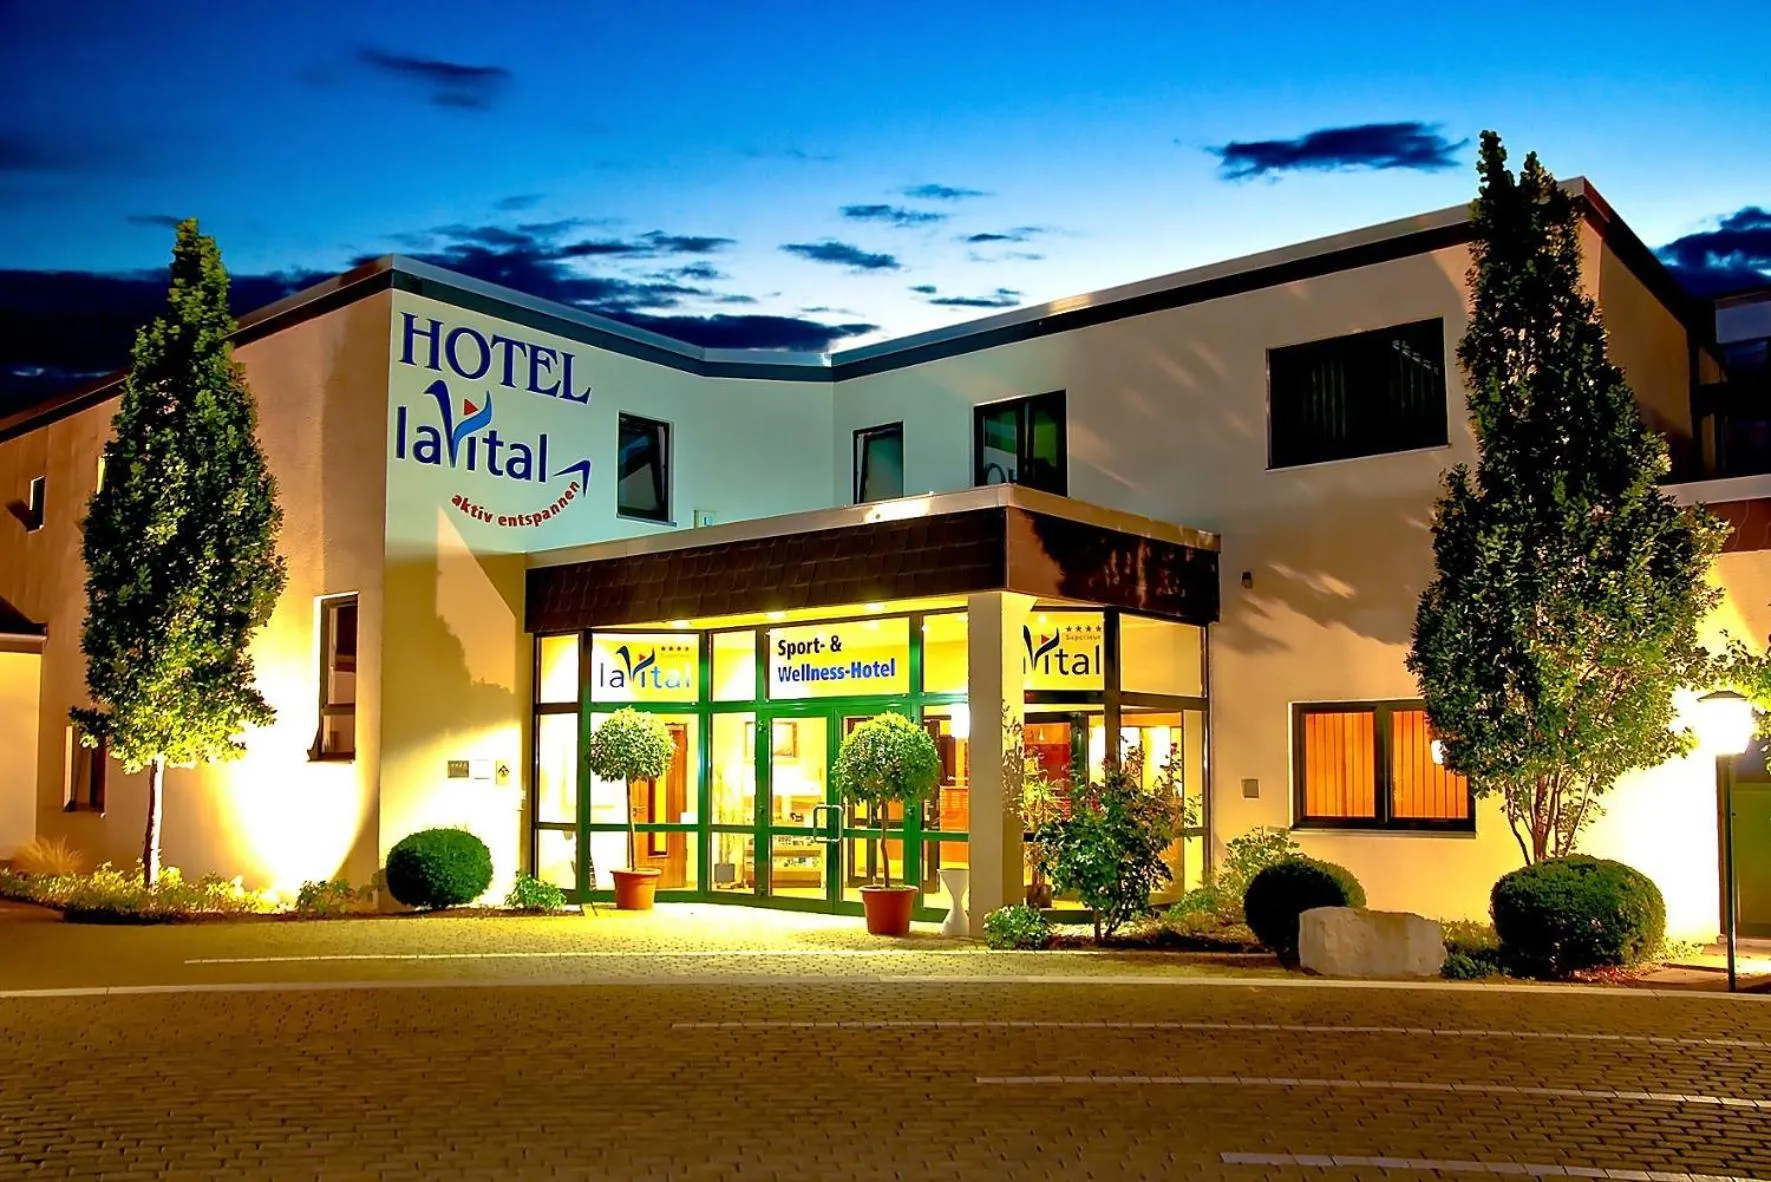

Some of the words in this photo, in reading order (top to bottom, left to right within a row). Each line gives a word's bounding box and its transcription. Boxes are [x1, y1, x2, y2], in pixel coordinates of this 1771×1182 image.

[399, 312, 592, 404] HOTEL
[396, 379, 548, 483] laVital
[452, 495, 493, 522] aktiv
[498, 480, 580, 526] entspannen
[777, 638, 825, 660] Sport-
[830, 635, 842, 652] &
[778, 658, 896, 682] Wellness-Hotel
